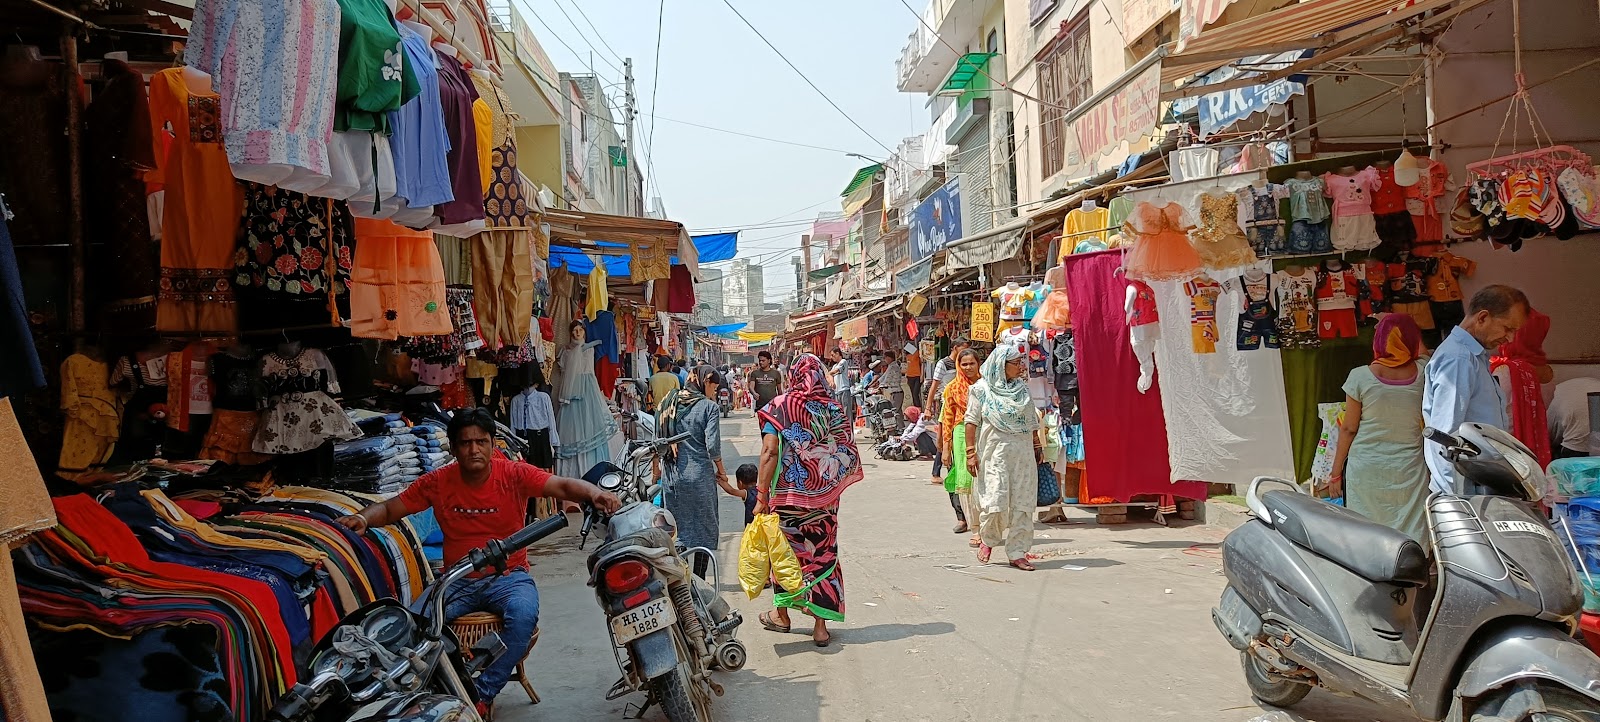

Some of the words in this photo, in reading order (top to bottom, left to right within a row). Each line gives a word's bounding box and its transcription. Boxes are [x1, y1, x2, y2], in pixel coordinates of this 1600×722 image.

[975, 313, 990, 321] 250
[974, 331, 989, 339] 250
[1495, 522, 1511, 531] HR
[1513, 522, 1531, 532] 11E
[622, 611, 639, 626] HR
[633, 618, 658, 635] 1828
